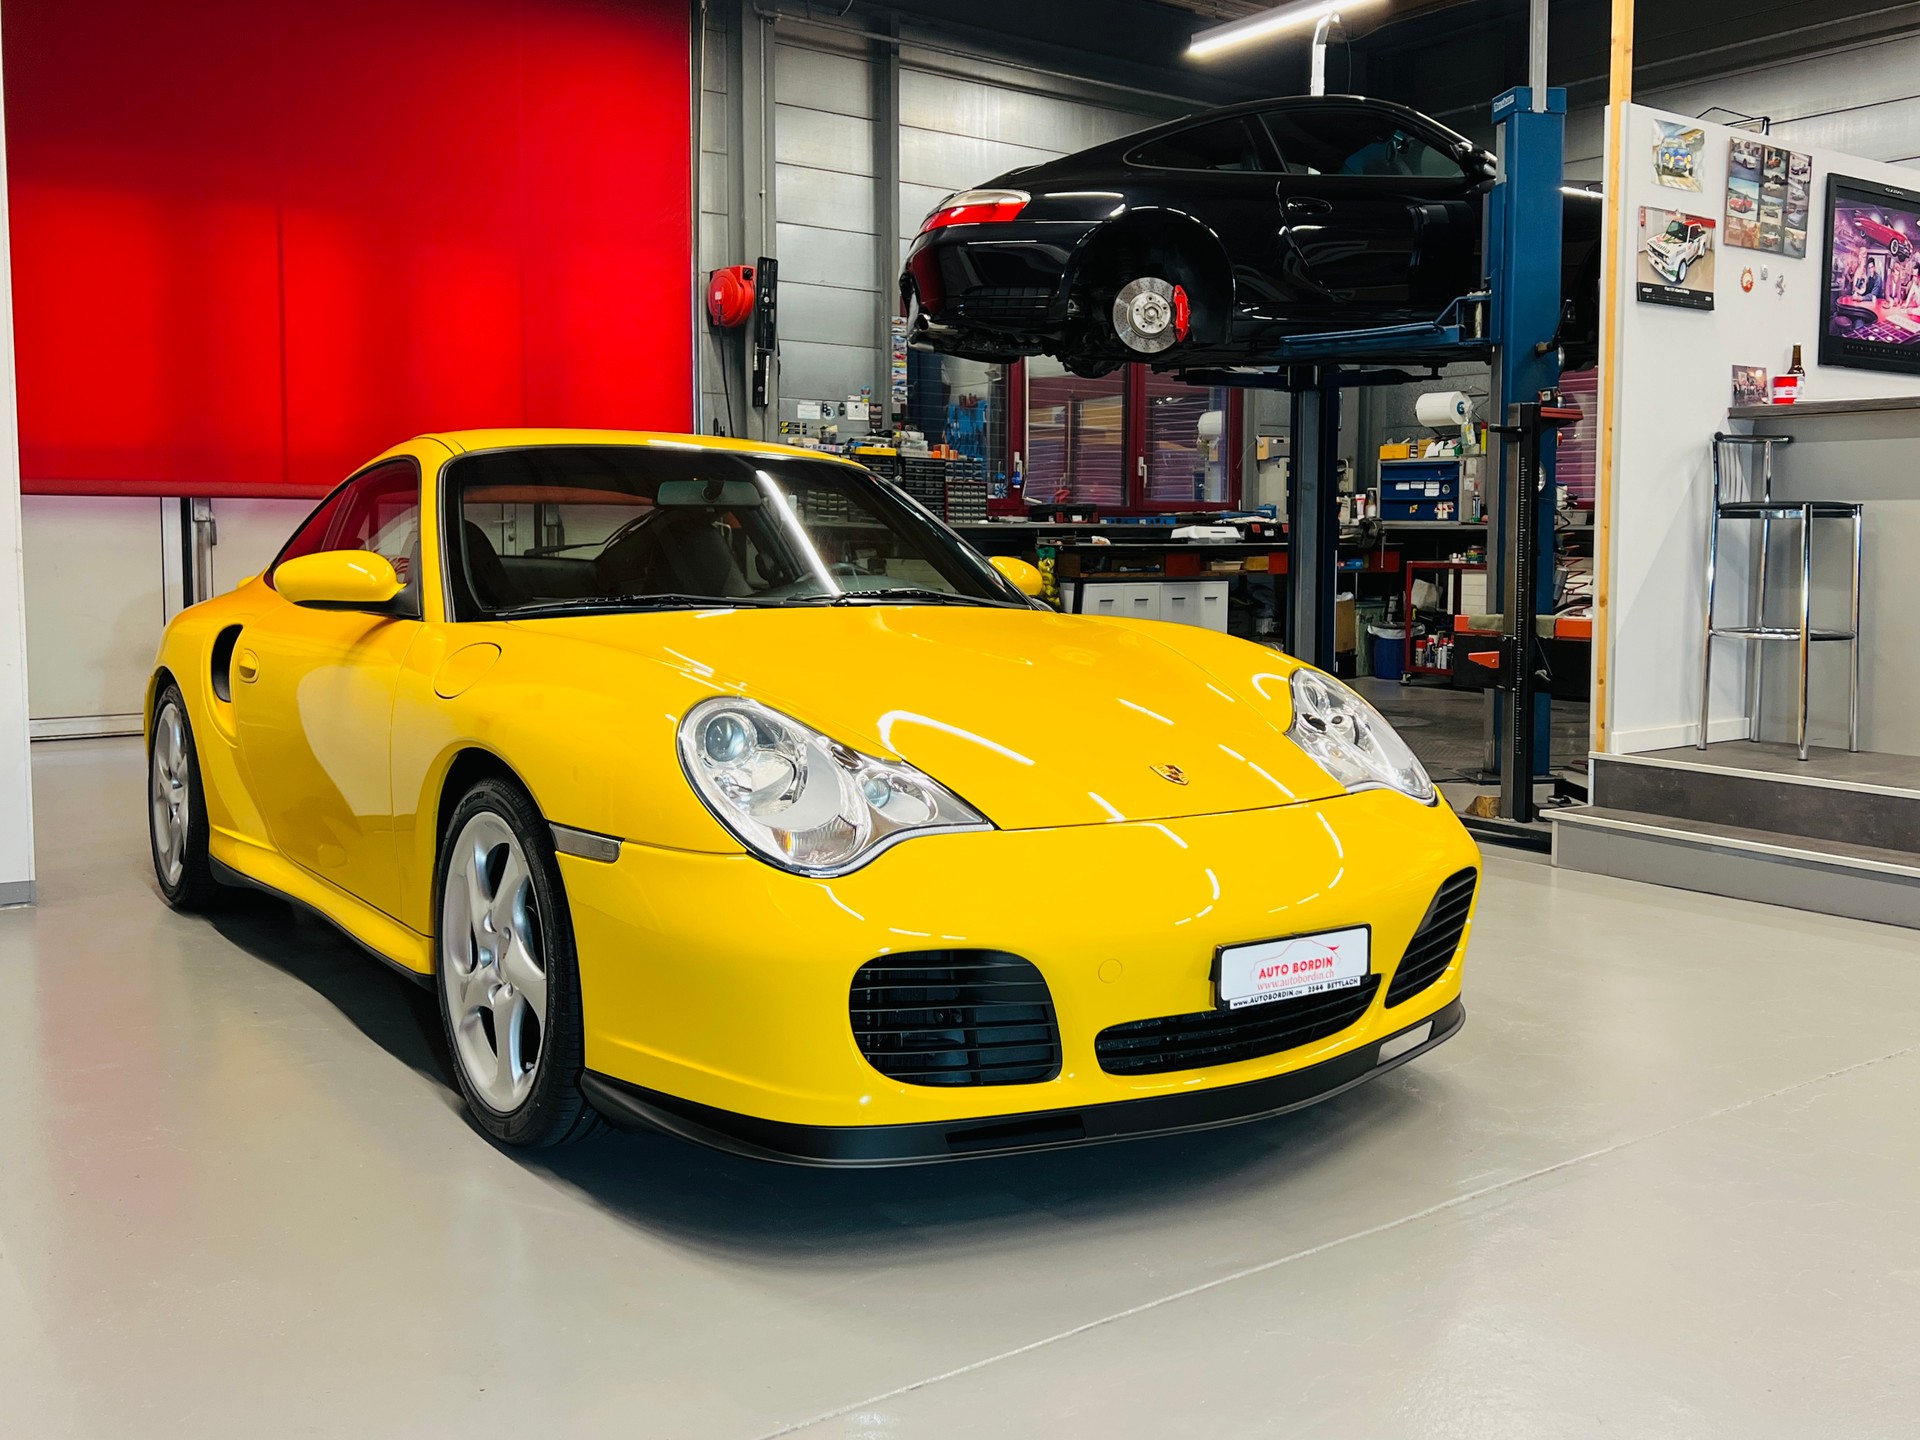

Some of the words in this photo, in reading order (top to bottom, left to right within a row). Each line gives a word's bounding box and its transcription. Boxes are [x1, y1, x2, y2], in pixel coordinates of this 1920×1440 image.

[1259, 964, 1289, 979] AUTO
[1293, 957, 1333, 973] BORDIN
[1257, 969, 1334, 991] www.autobordin.ch
[1327, 978, 1358, 989] BETTLACH
